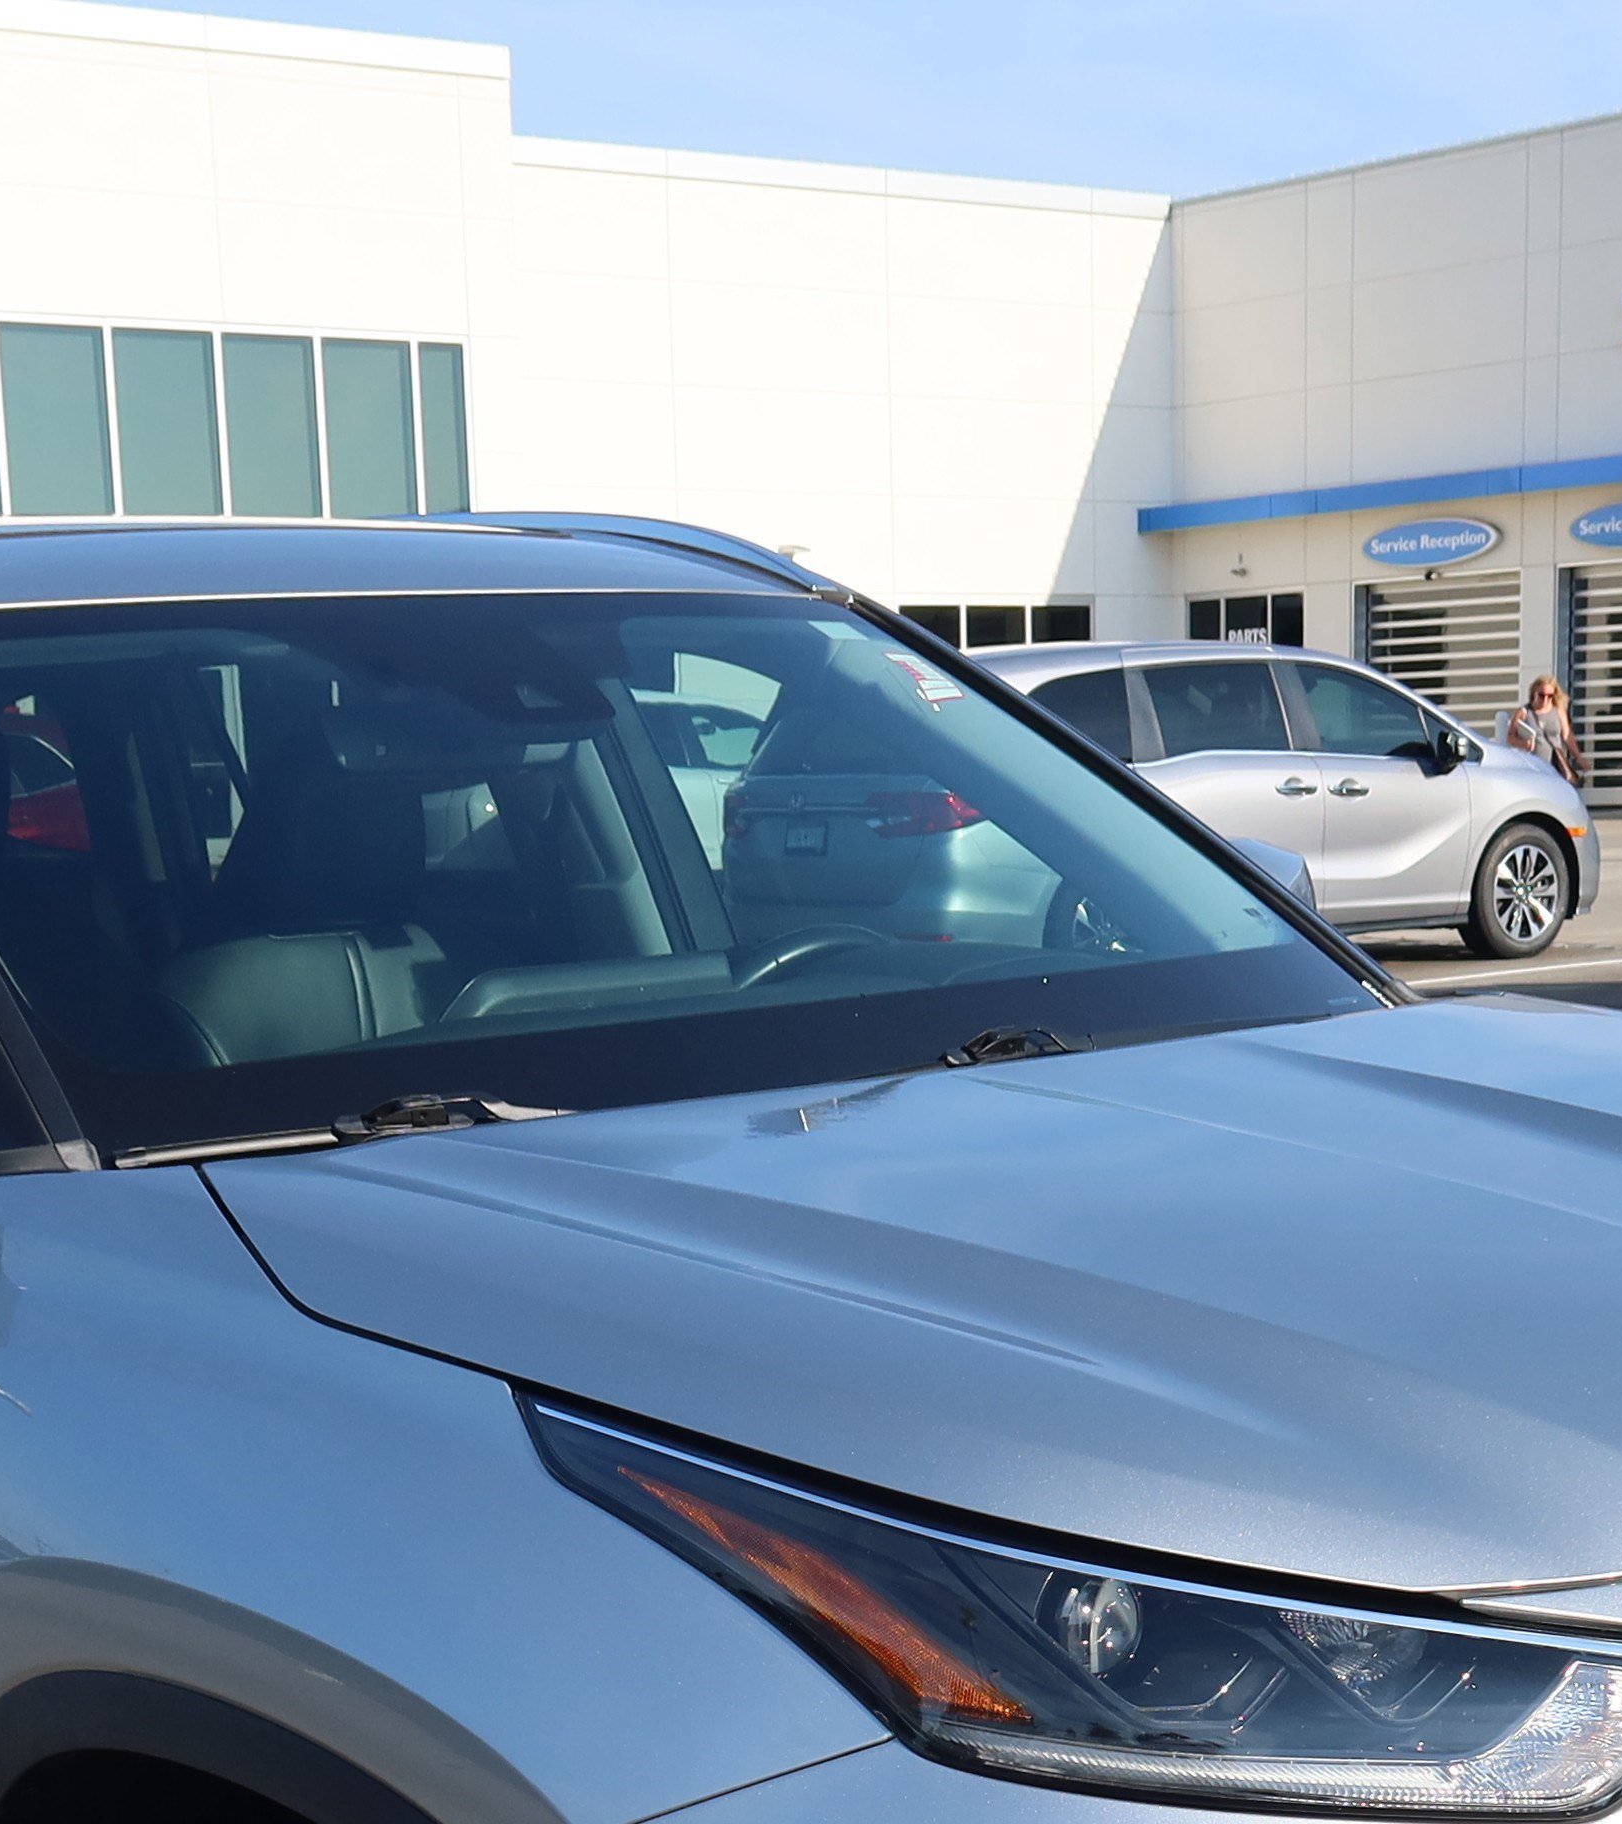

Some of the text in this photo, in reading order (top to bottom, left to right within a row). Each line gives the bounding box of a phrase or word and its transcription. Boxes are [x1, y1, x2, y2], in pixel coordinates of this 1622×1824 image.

[1370, 529, 1486, 555] Service Reception
[1227, 627, 1267, 643] PARTS
